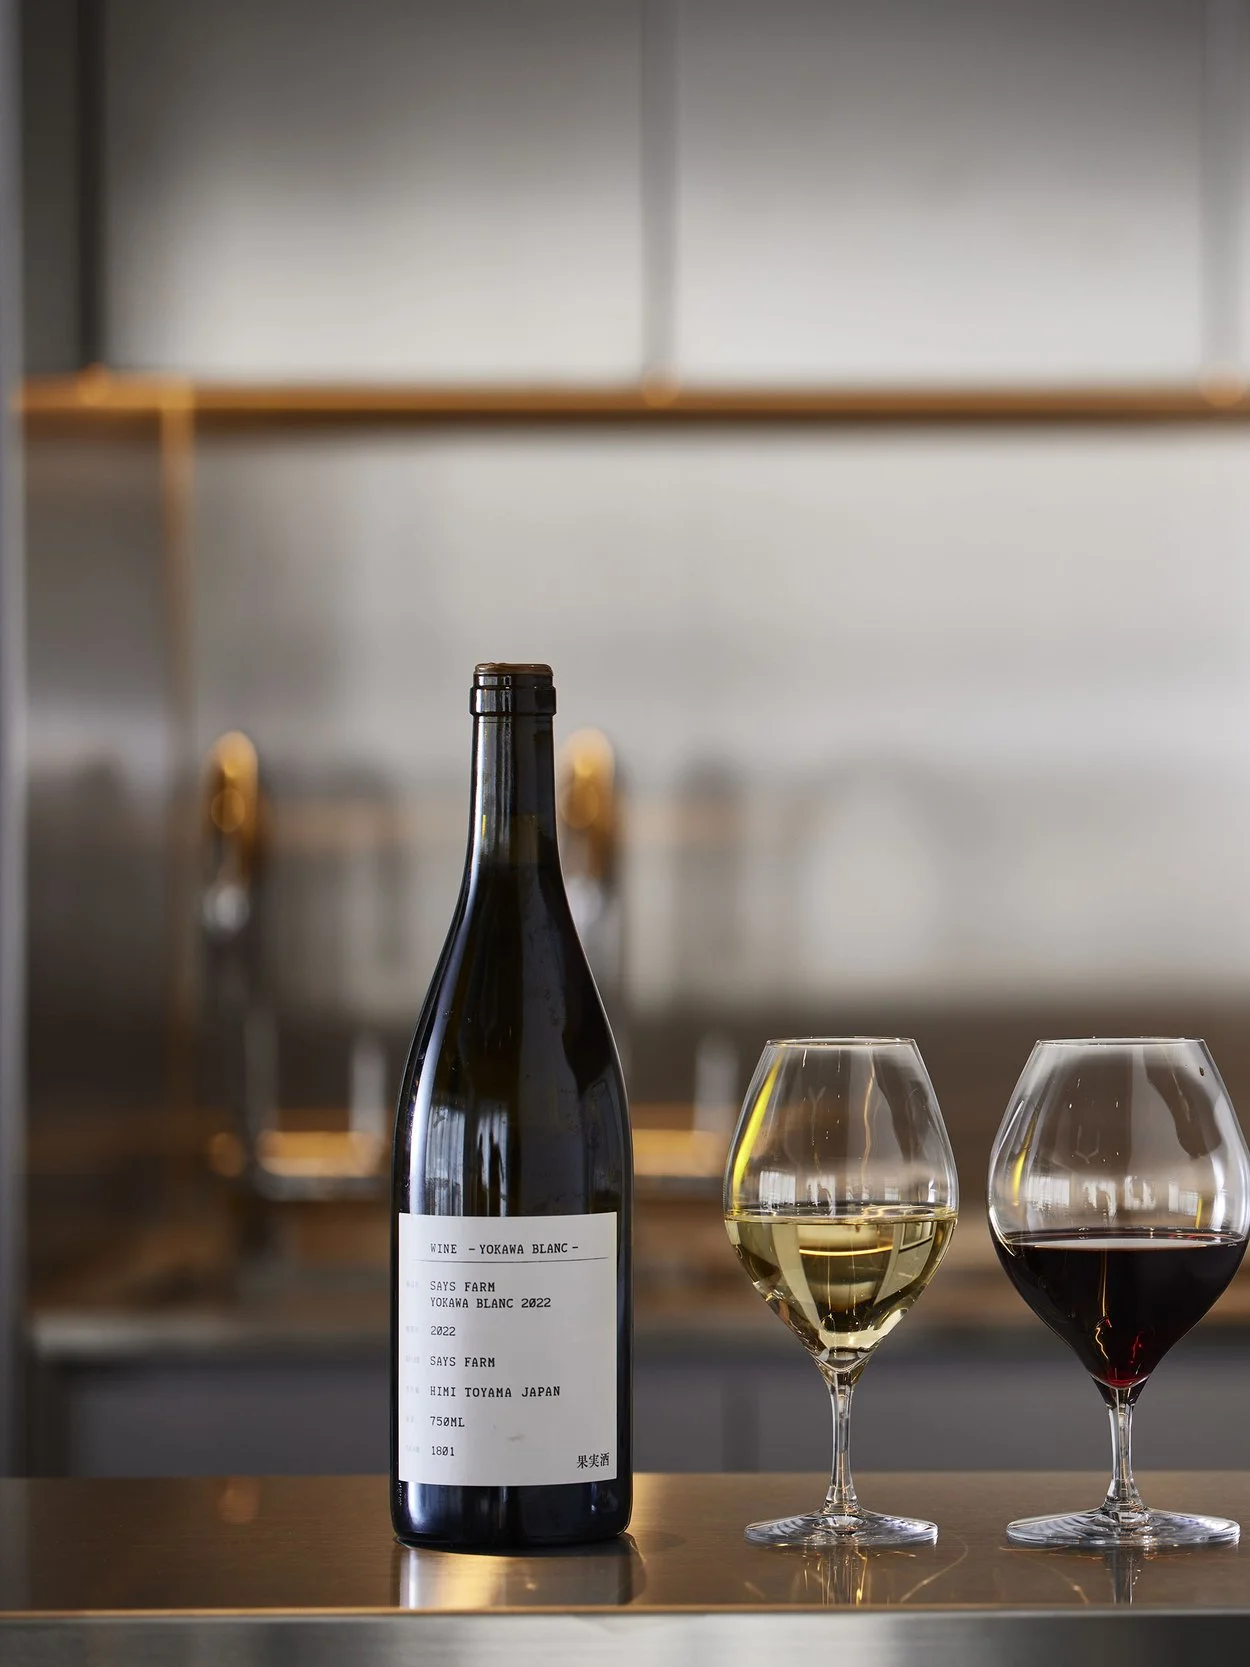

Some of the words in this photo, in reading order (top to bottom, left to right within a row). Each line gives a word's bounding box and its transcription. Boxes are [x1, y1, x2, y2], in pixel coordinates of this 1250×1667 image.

[430, 1243, 457, 1255] WINE
[430, 1281, 456, 1292] SAYS
[464, 1282, 495, 1292] FARM
[430, 1297, 469, 1308] YOKAWA
[476, 1298, 514, 1309] BLANC
[521, 1298, 551, 1308] 2022
[430, 1326, 456, 1336] 2022
[430, 1356, 456, 1367] SAYS
[464, 1357, 495, 1367] FARM
[430, 1386, 456, 1397] HIMI
[465, 1387, 512, 1398] TOYAMA
[521, 1386, 560, 1397] JAPAN
[430, 1416, 465, 1428] 750ML
[431, 1446, 454, 1456] 1801
[577, 1452, 609, 1469] 果実酒
